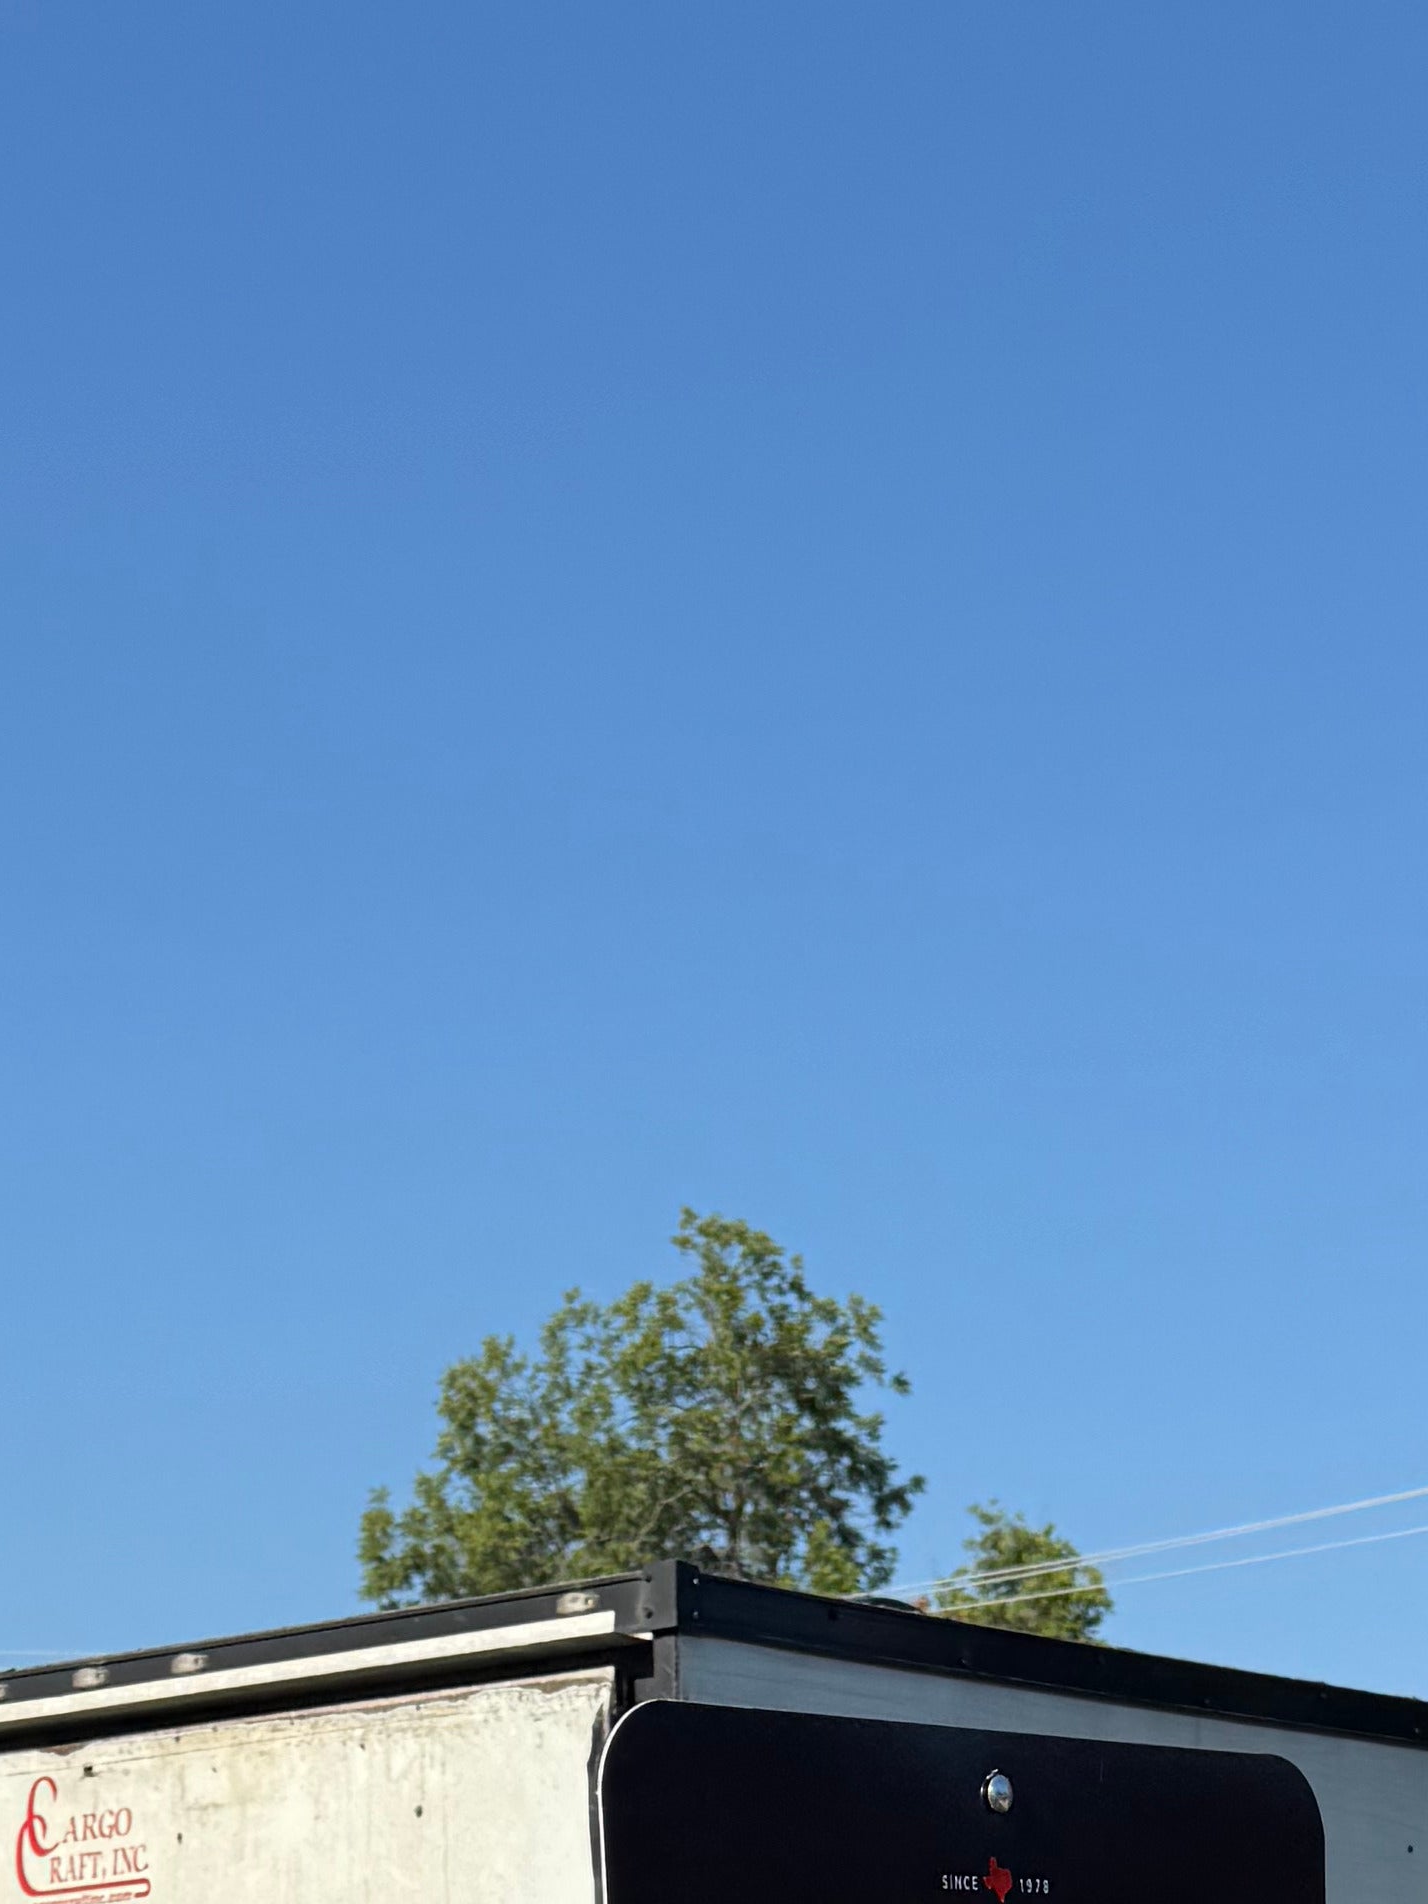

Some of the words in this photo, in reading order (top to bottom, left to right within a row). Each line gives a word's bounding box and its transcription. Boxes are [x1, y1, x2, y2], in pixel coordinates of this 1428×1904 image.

[27, 1775, 133, 1857] CARGO
[941, 1874, 979, 1891] SINCE
[1019, 1878, 1049, 1894] 1978
